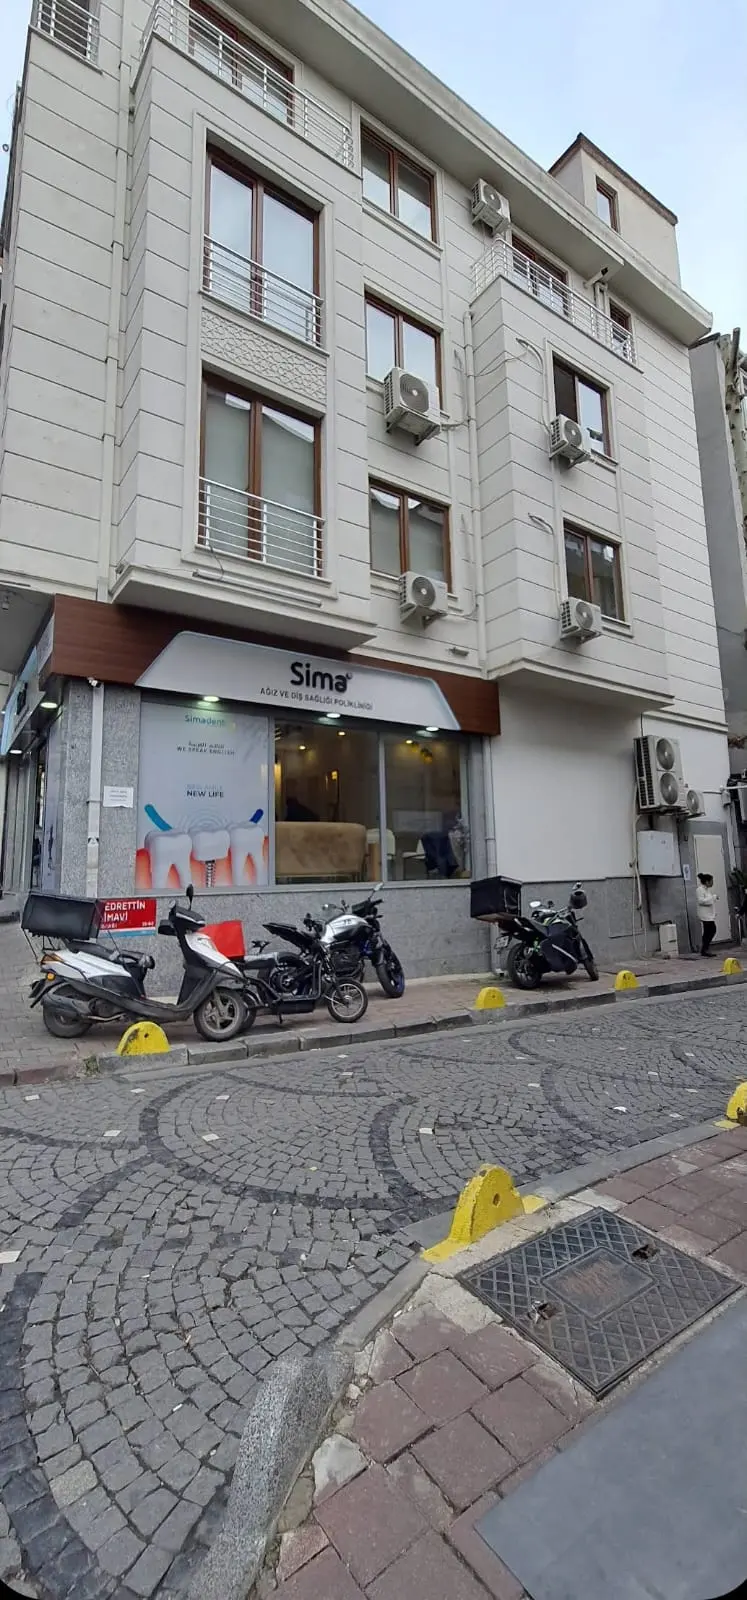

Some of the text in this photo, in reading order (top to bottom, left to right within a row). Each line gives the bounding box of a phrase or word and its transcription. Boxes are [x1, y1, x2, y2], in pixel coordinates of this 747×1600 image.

[290, 661, 348, 693] Sima
[260, 687, 278, 697] AĞIZ
[280, 690, 289, 699] VE
[291, 691, 303, 701] DİŞ
[304, 694, 333, 704] SAĞLIĞI
[186, 789, 224, 799] NEW LIFE
[104, 900, 146, 911] EDRETTİN
[103, 910, 128, 922] İMAVİ
